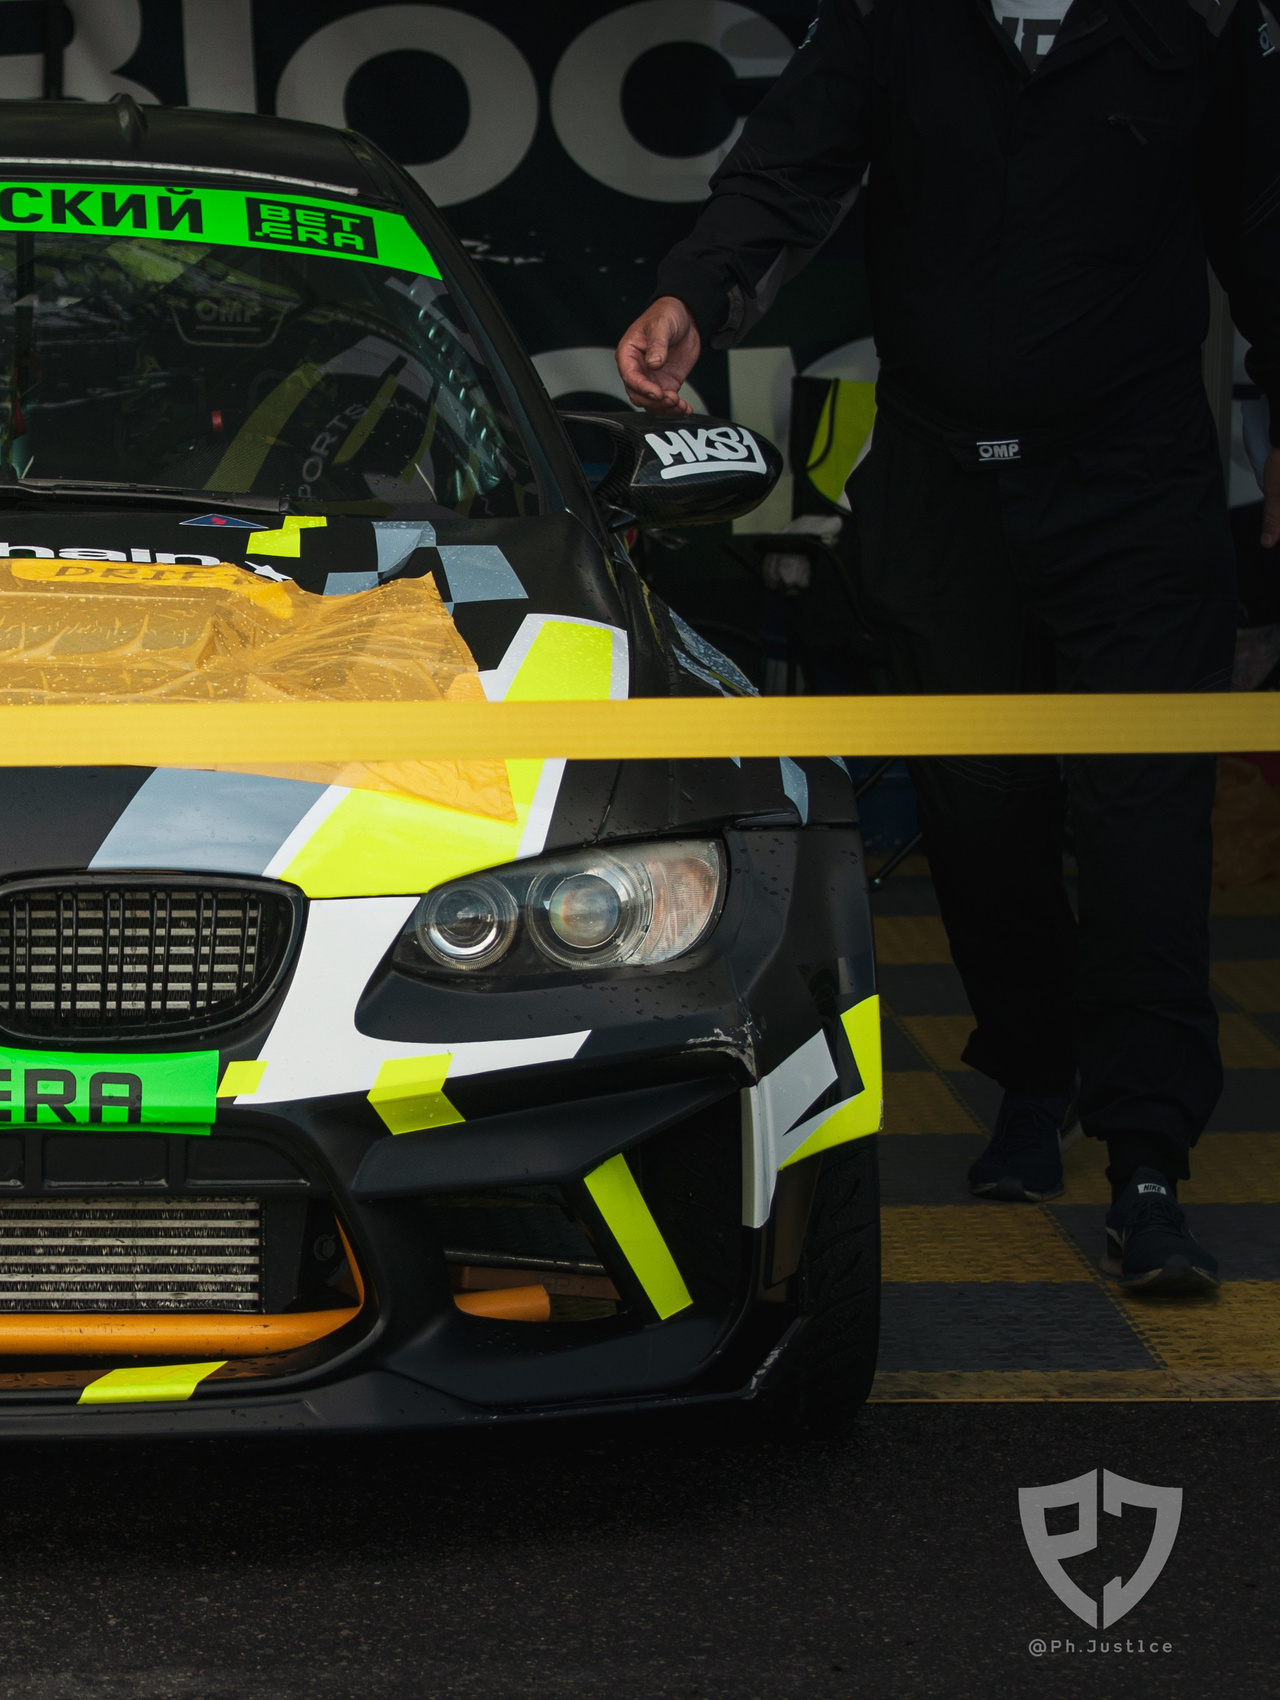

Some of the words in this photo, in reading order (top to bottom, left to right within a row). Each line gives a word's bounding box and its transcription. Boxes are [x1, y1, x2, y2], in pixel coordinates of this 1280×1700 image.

[258, 204, 362, 233] BET
[296, 403, 369, 504] PORTS
[978, 443, 1019, 458] OMP
[1143, 1184, 1162, 1193] NIKE
